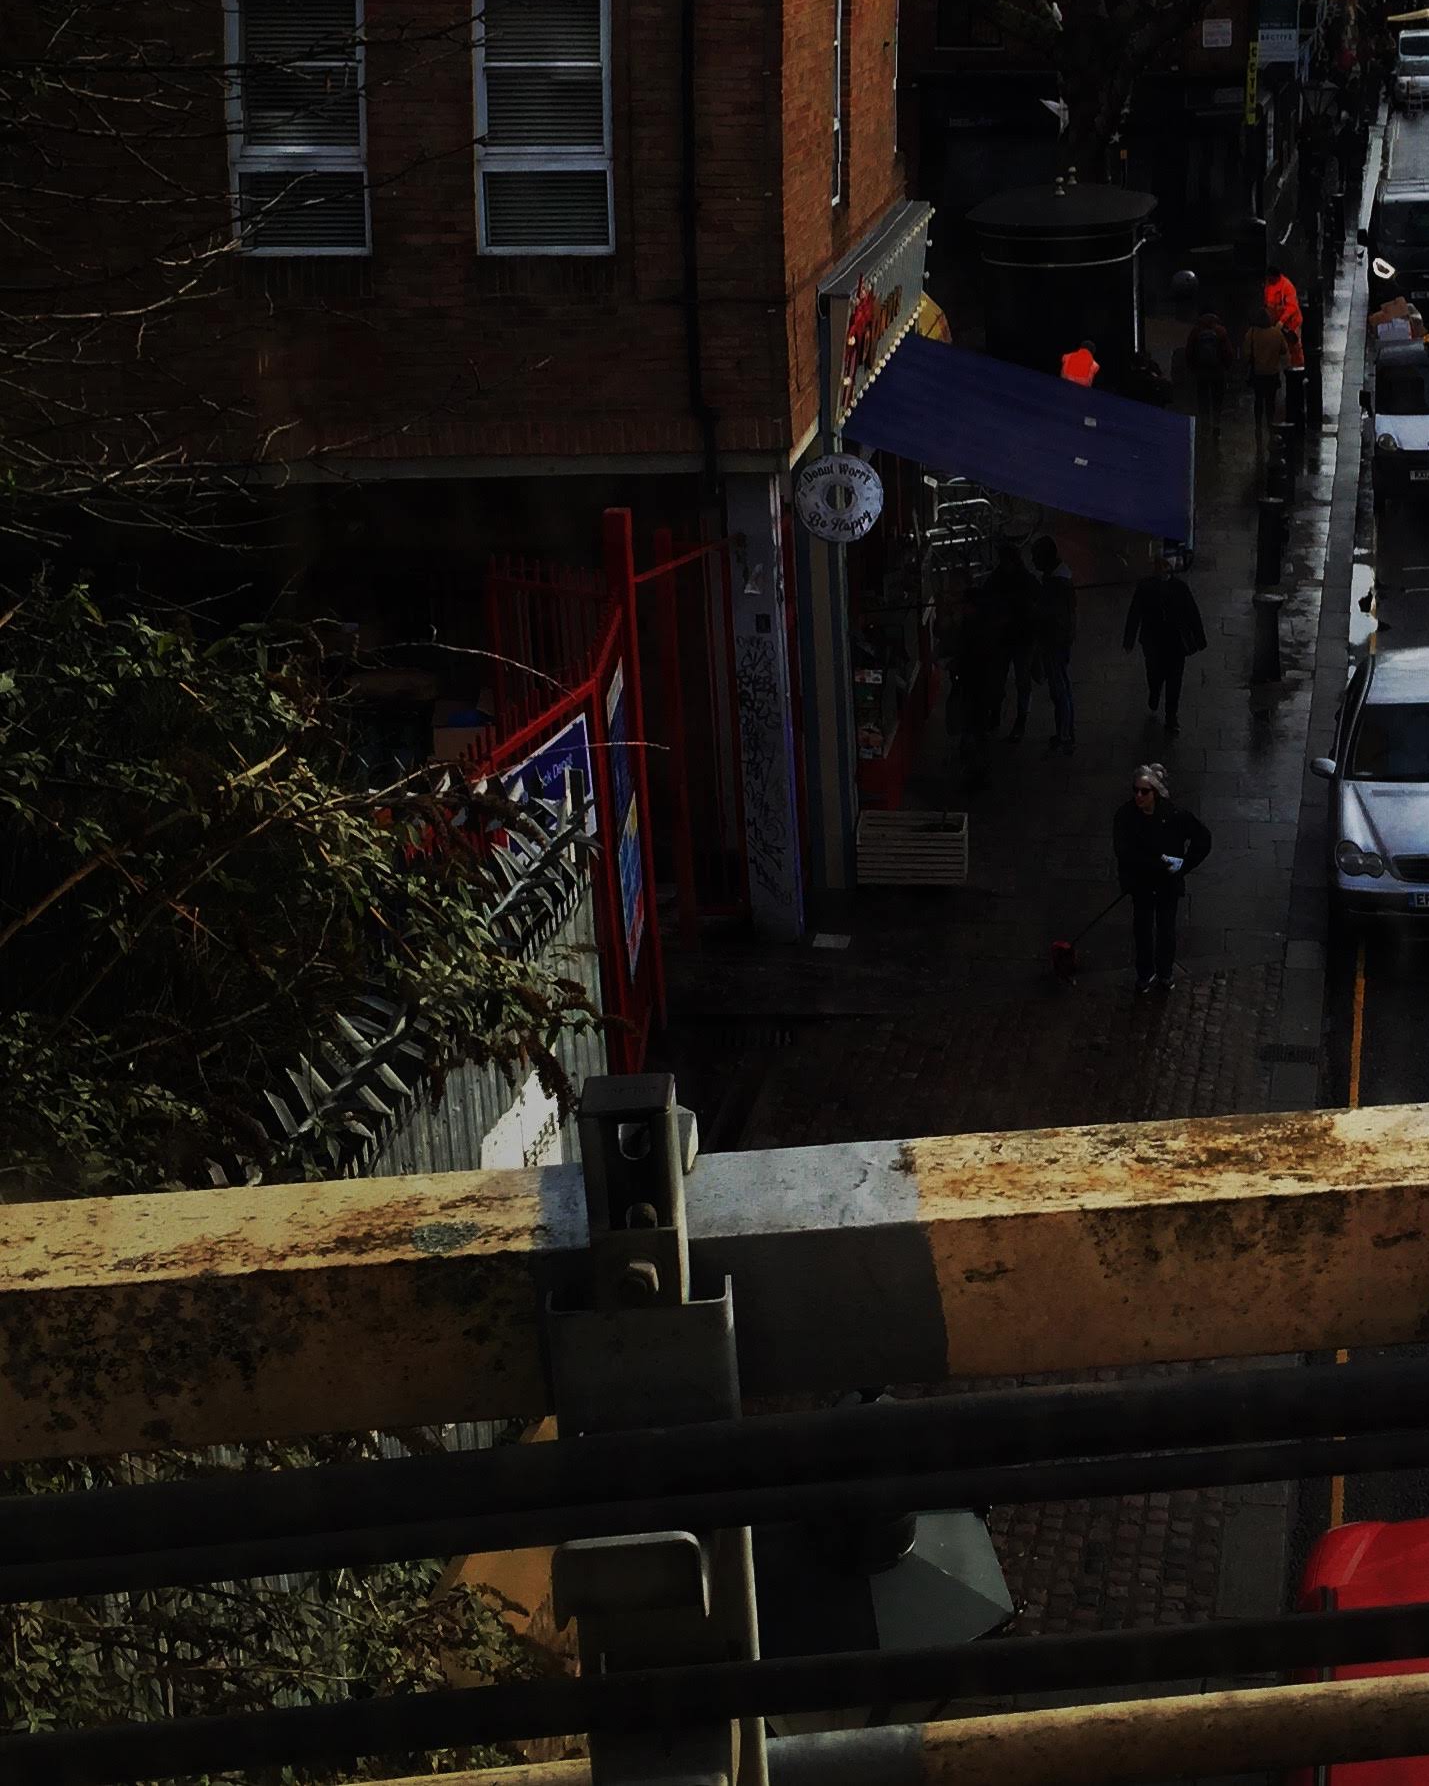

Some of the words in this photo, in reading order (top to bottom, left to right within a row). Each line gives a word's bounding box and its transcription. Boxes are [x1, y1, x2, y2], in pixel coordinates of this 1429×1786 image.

[803, 464, 834, 483] Donut
[839, 463, 872, 485] Worry
[807, 511, 828, 529] Be
[831, 510, 873, 535] Happy
